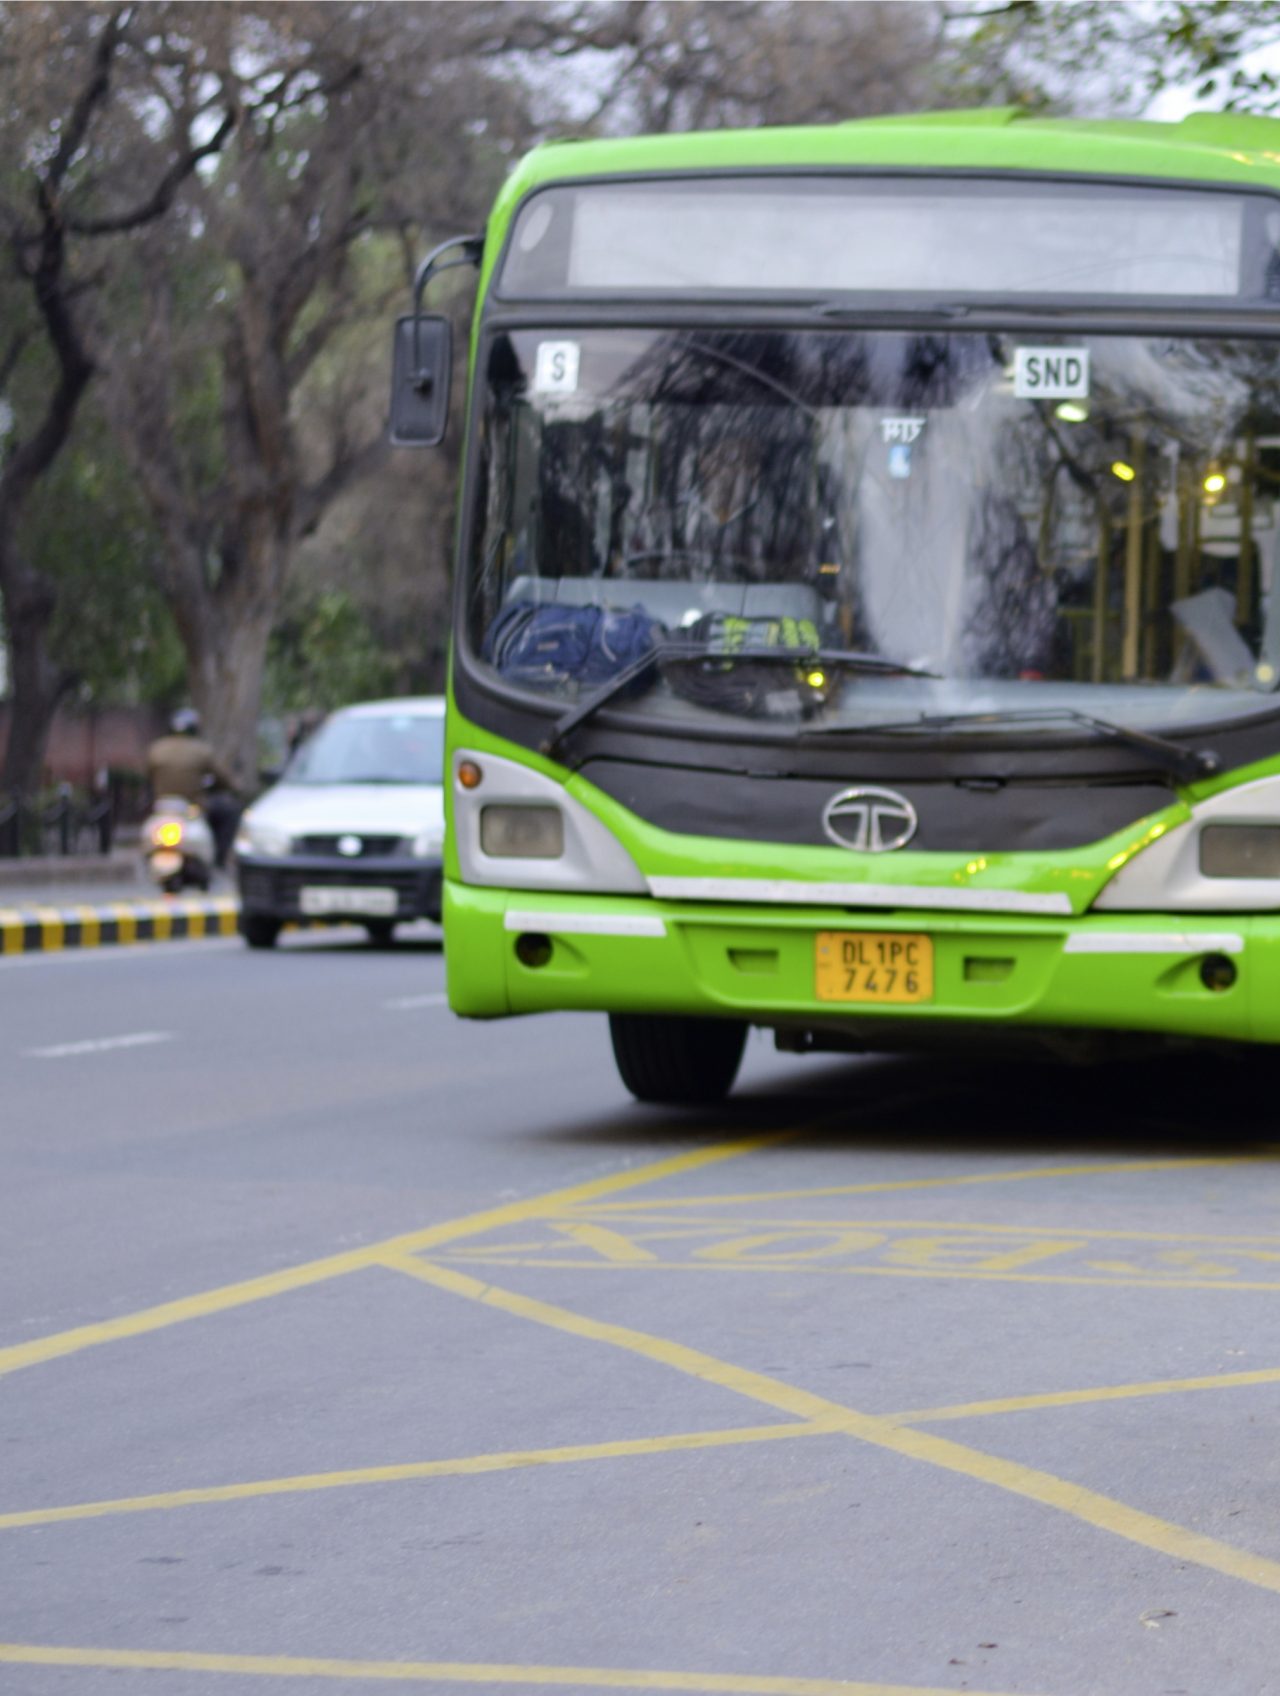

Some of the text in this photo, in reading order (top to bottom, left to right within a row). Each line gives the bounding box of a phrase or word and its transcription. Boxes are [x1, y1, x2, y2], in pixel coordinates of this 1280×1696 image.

[551, 350, 566, 382] S
[1026, 356, 1082, 388] SND
[842, 939, 919, 966] DL1PC
[844, 968, 919, 994] 7476
